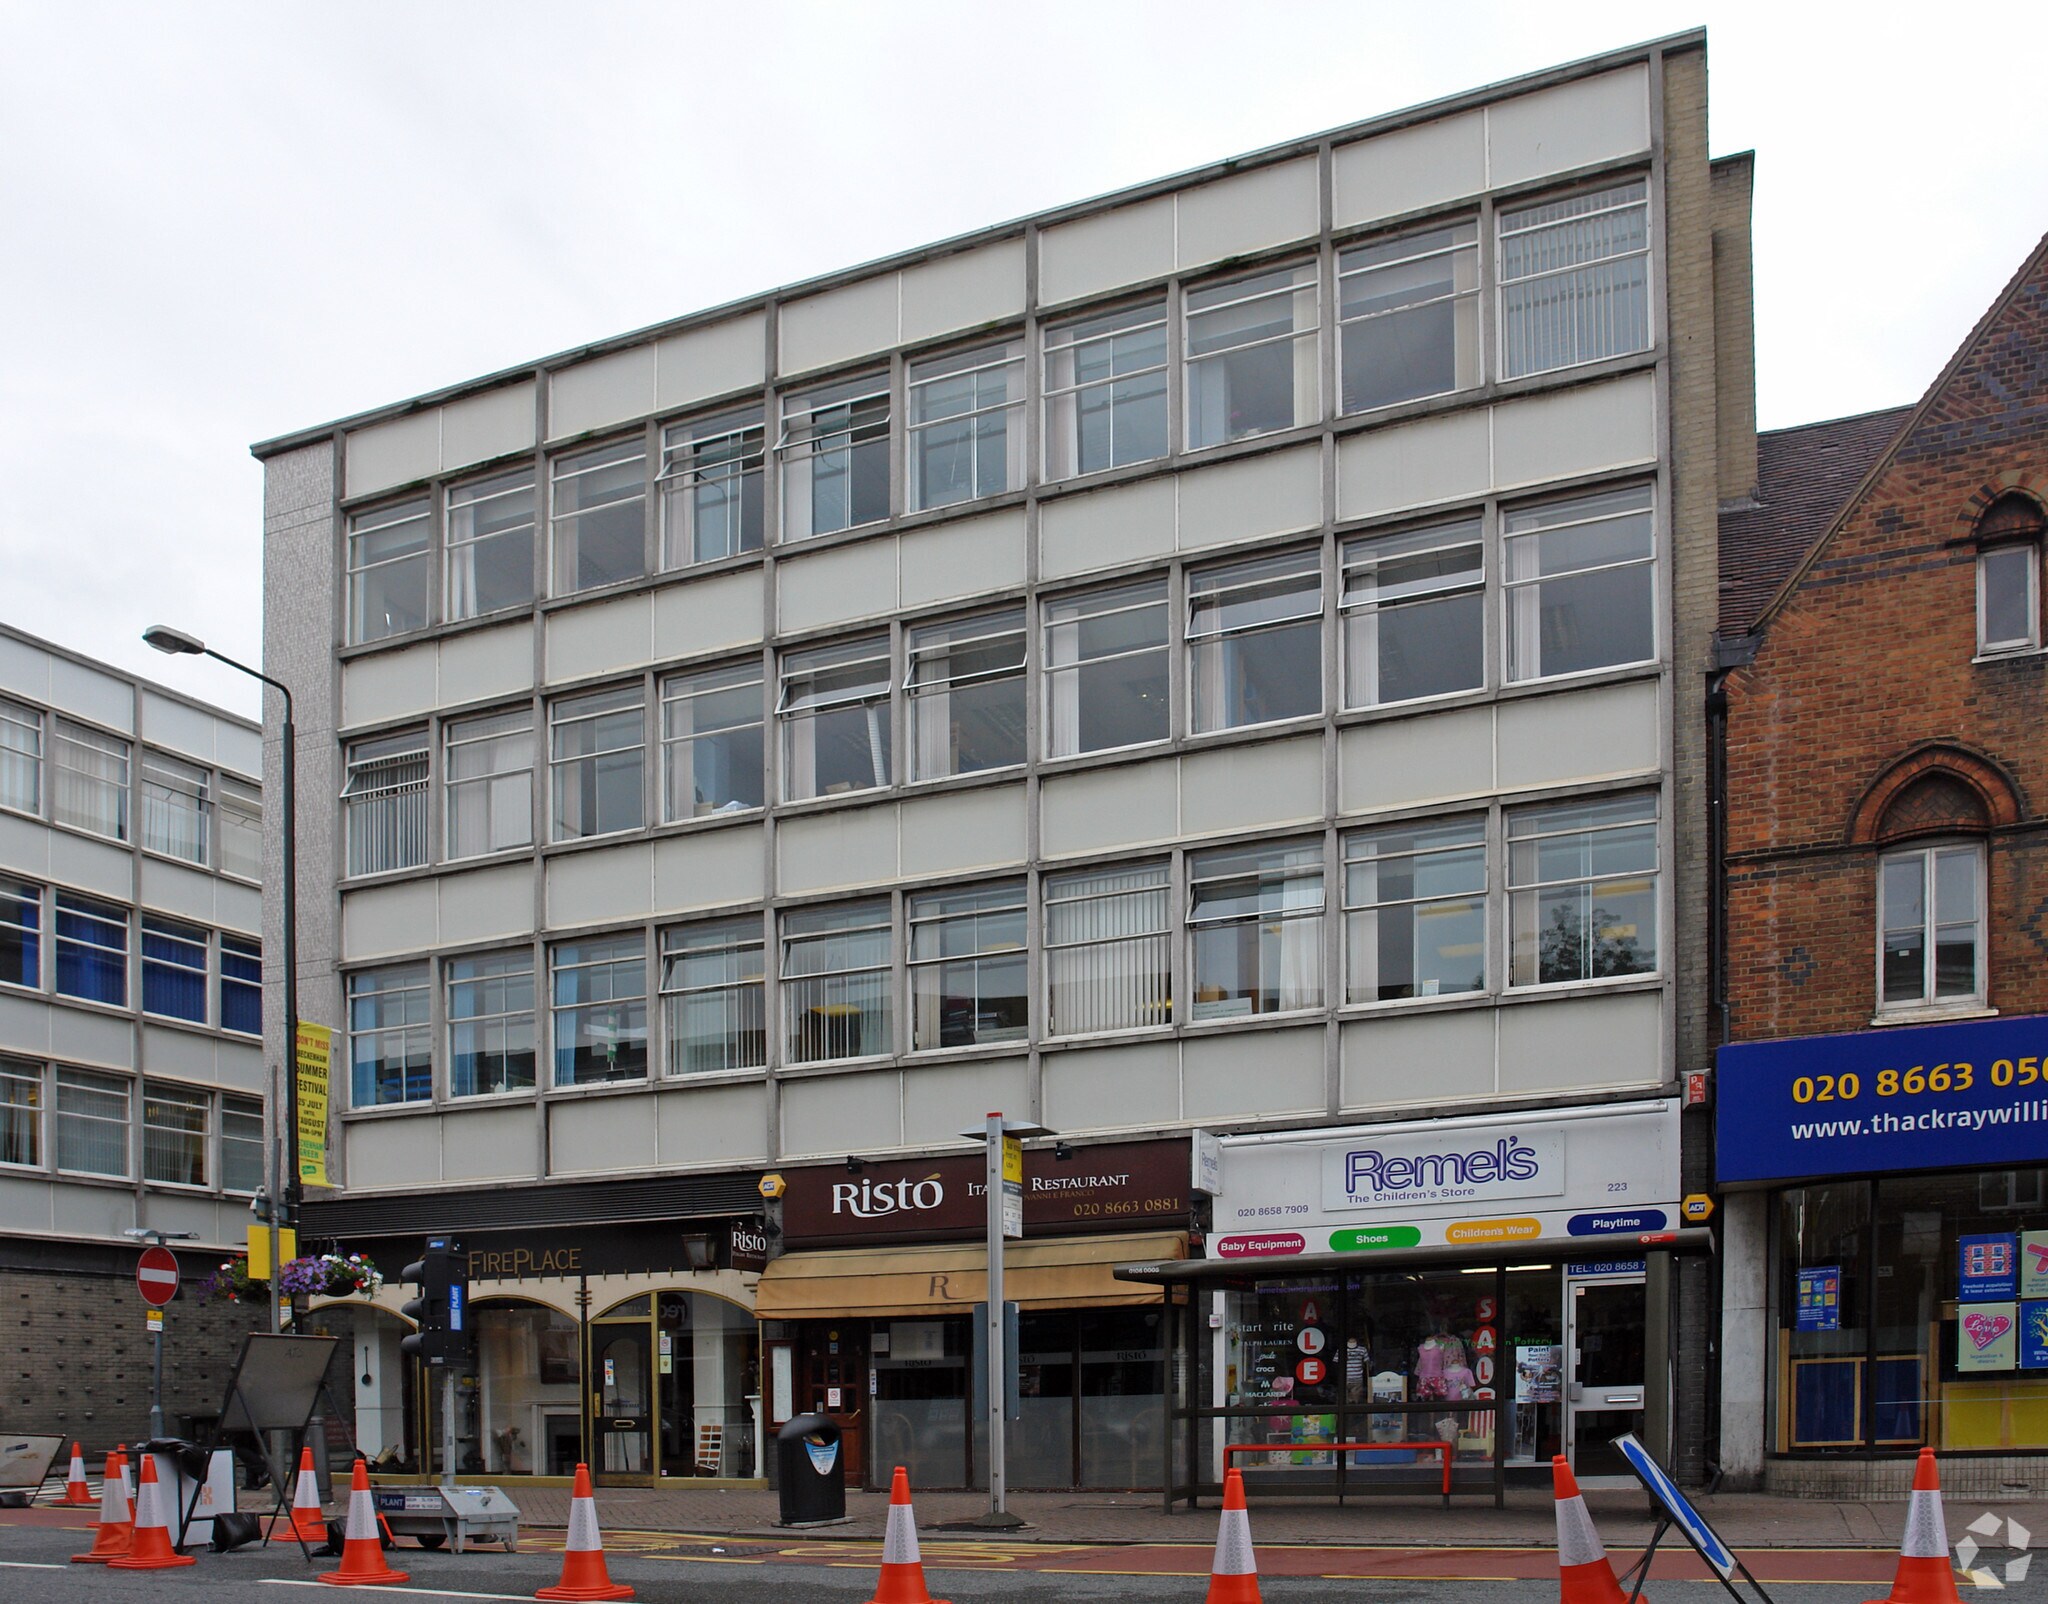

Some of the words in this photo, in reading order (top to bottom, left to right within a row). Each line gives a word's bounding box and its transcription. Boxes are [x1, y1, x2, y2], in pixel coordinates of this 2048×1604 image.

[296, 1063, 328, 1079] SUMMER
[1791, 1072, 1860, 1104] 020
[1875, 1062, 1974, 1097] 8663
[307, 1098, 323, 1110] JULY
[1345, 1135, 1539, 1194] Remel's
[1032, 1173, 1129, 1191] RESTAURANT
[1607, 1182, 1629, 1193] 223
[1347, 1194, 1370, 1204] The
[1374, 1188, 1437, 1202] Children's
[1441, 1186, 1476, 1198] Store
[1074, 1202, 1100, 1217] 020
[1104, 1199, 1139, 1214] 8663
[1144, 1197, 1179, 1212] 0881
[1237, 1208, 1256, 1218] 020
[1258, 1206, 1282, 1216] 8658
[1285, 1204, 1309, 1215] 7909
[1688, 1203, 1706, 1212] ADT
[1592, 1215, 1641, 1229] Playtime
[1452, 1226, 1504, 1239] Children's
[1506, 1224, 1535, 1236] Wear
[1220, 1242, 1246, 1253] Baby
[1248, 1238, 1302, 1251] Equipment
[1355, 1233, 1389, 1245] Shoes
[1569, 1264, 1592, 1273] TEL:
[1594, 1262, 1612, 1272] 020
[1614, 1261, 1639, 1271] 8658
[1527, 1346, 1550, 1354] Paint
[380, 1498, 404, 1507] PLANT
